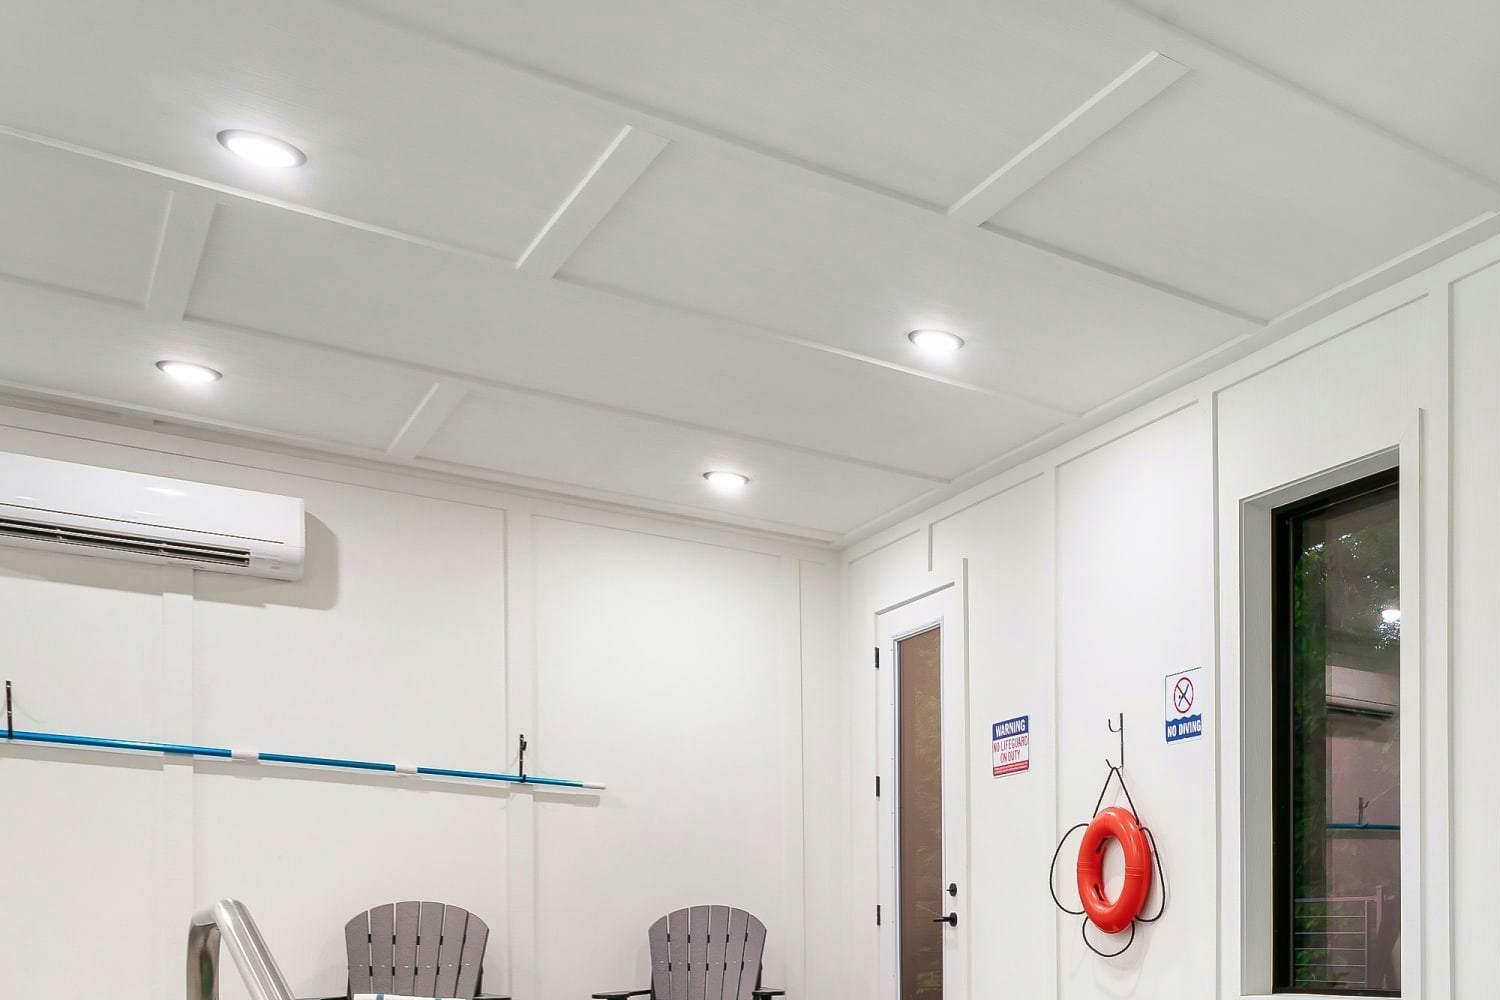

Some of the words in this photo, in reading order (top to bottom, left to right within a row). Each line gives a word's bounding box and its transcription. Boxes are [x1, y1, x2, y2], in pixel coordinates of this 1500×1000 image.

[996, 719, 1025, 737] WARNING
[1167, 725, 1176, 737] NO
[1179, 720, 1201, 735] DIVING
[1001, 736, 1028, 751] LIFEGUARD
[1008, 750, 1020, 761] DUTY
